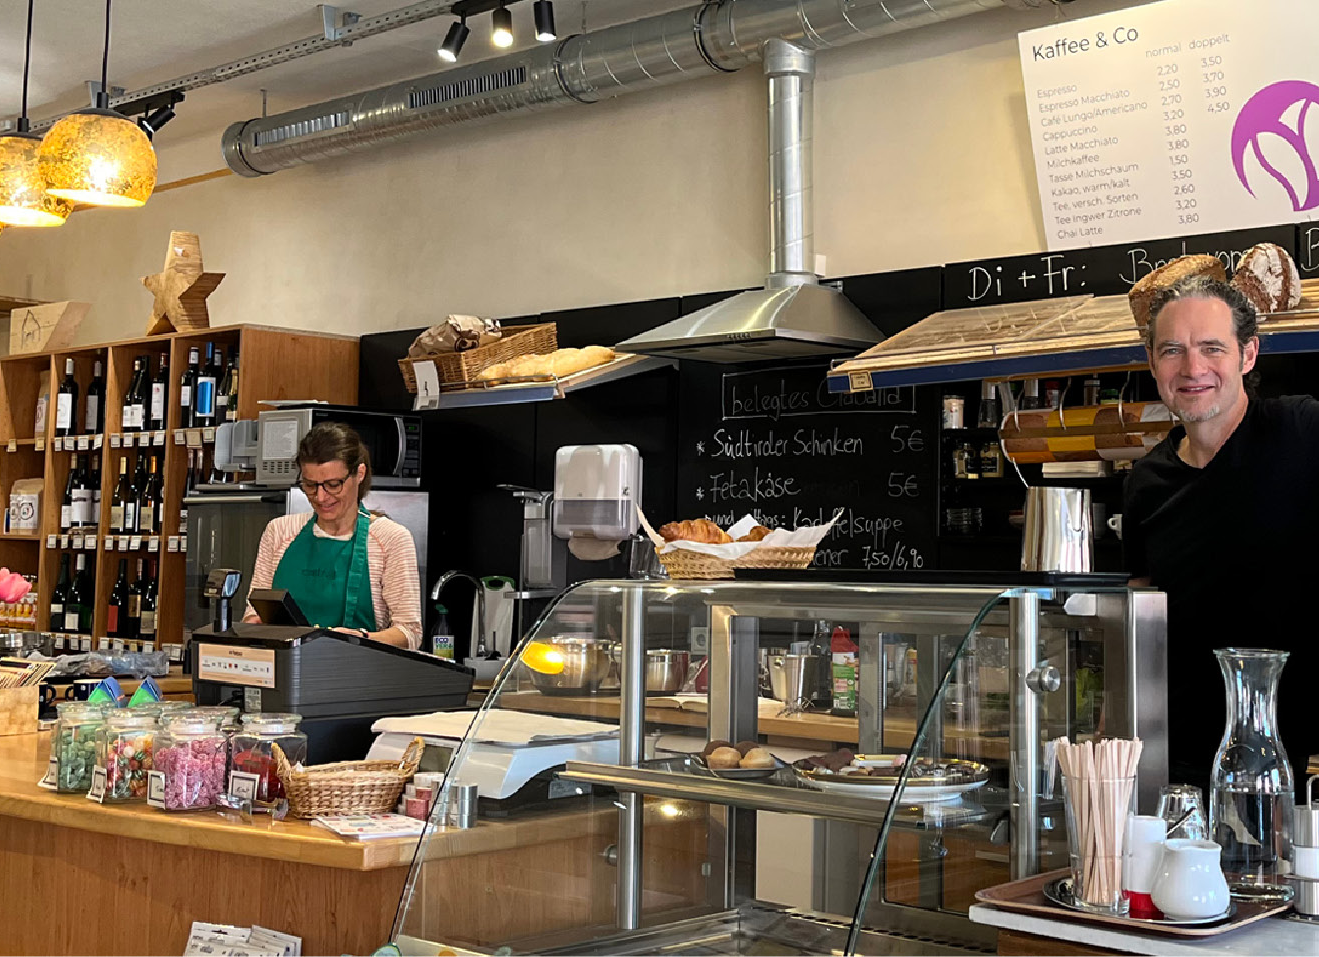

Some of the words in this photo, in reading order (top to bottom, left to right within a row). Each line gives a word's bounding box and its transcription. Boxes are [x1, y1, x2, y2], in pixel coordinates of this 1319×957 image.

[1032, 38, 1090, 61] Kaffee
[1096, 32, 1107, 48] &
[1113, 27, 1139, 44] Co
[1145, 42, 1182, 58] normal
[1189, 33, 1230, 51] doppelt
[1037, 84, 1077, 99] Espresso
[1157, 64, 1178, 76] 2,20
[1201, 56, 1222, 68] 3,50
[1039, 99, 1078, 113] Espresso
[1081, 89, 1130, 104] Macchiato
[1159, 79, 1180, 91] 2,50
[1203, 72, 1224, 83] 3,70
[1161, 95, 1182, 106] 2,70
[1205, 86, 1226, 98] 3,90
[1043, 125, 1097, 142] Cappuccino
[1163, 109, 1184, 121] 3,20
[1208, 102, 1230, 114] 4,50
[1045, 144, 1067, 156] Latte
[1070, 136, 1118, 151] Macchiato
[1047, 154, 1100, 169] Milchkaffee
[1049, 172, 1073, 183] Tasse
[1075, 163, 1139, 179] Milchschaum
[1054, 214, 1071, 225] Tee
[1176, 199, 1197, 210] 3,20
[968, 266, 1003, 301] Di
[1041, 255, 1087, 294] Fr:
[793, 427, 862, 456] Schinken
